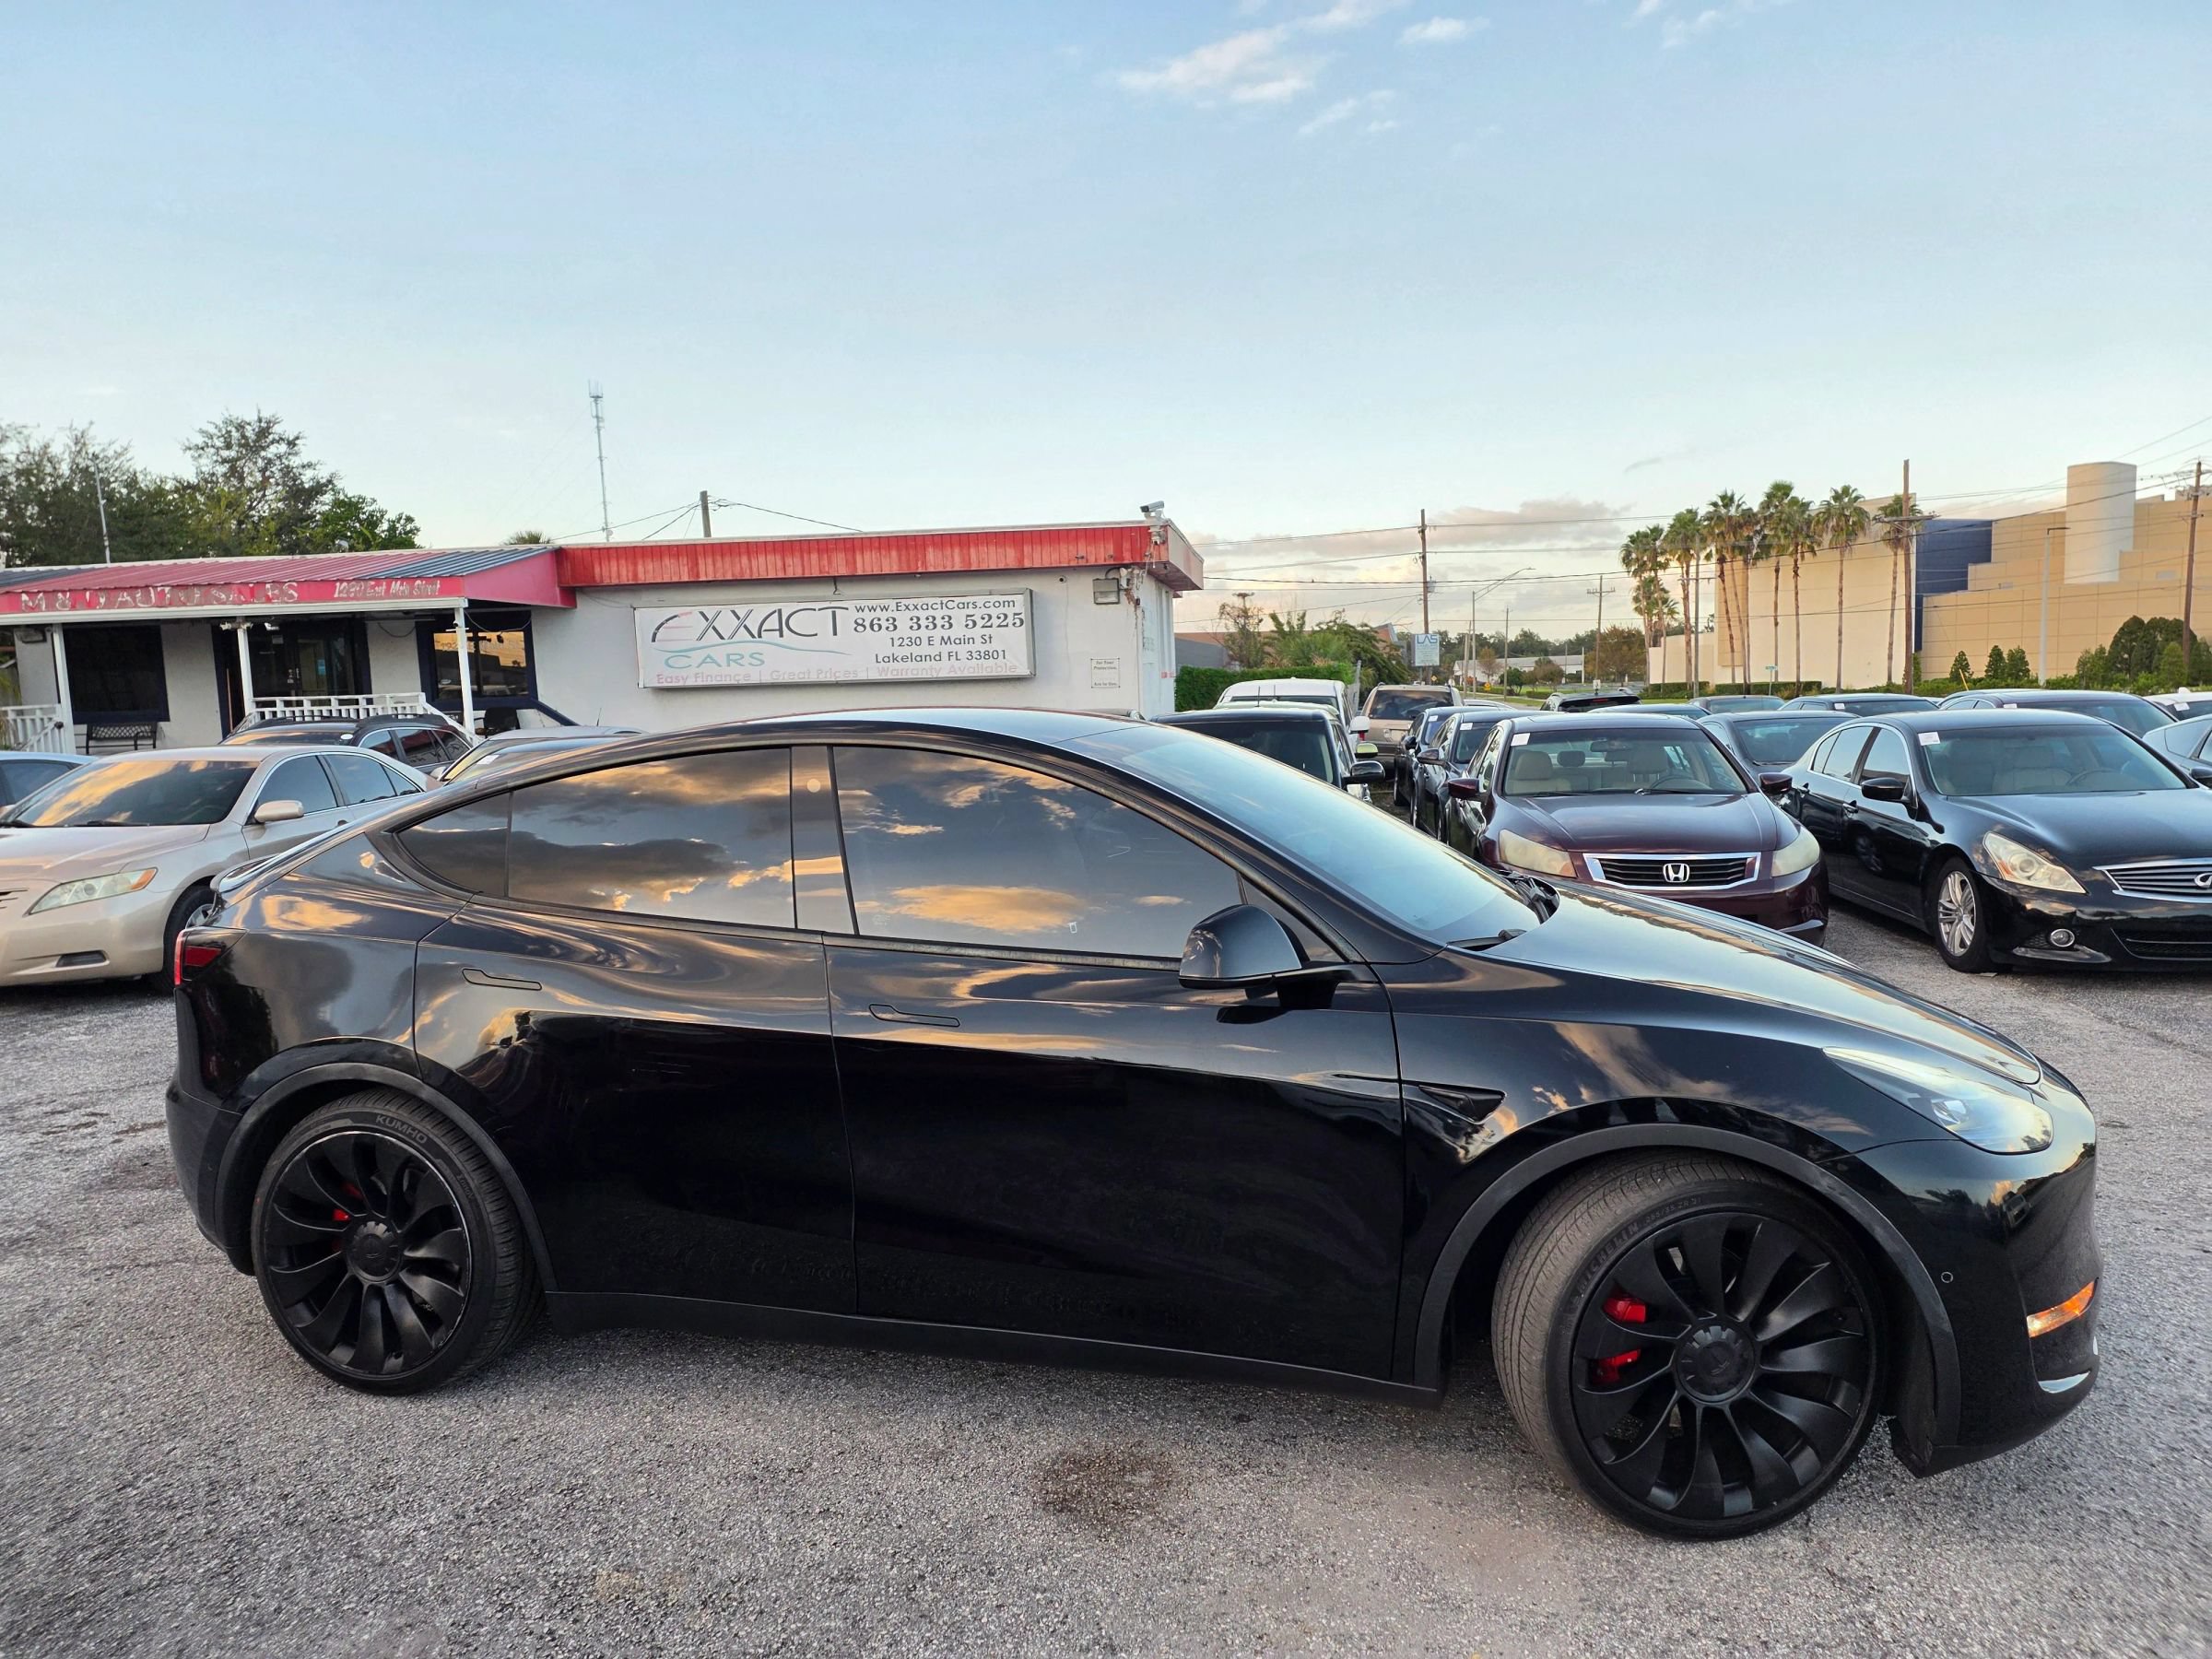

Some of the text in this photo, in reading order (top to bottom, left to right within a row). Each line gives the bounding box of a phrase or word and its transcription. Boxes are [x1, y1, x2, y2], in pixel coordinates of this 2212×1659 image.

[853, 599, 1017, 614] www.ExxactCars.com
[651, 606, 850, 643] EXXACT
[853, 611, 1025, 633] 863 333 5225
[889, 633, 994, 647] 1230 E Main St
[664, 652, 766, 669] CARS
[875, 649, 1006, 664] Lakeland FL 33801
[656, 662, 1018, 686] Easy Finance Great Prices Warranty Available
[375, 1114, 428, 1144] KUMHO
